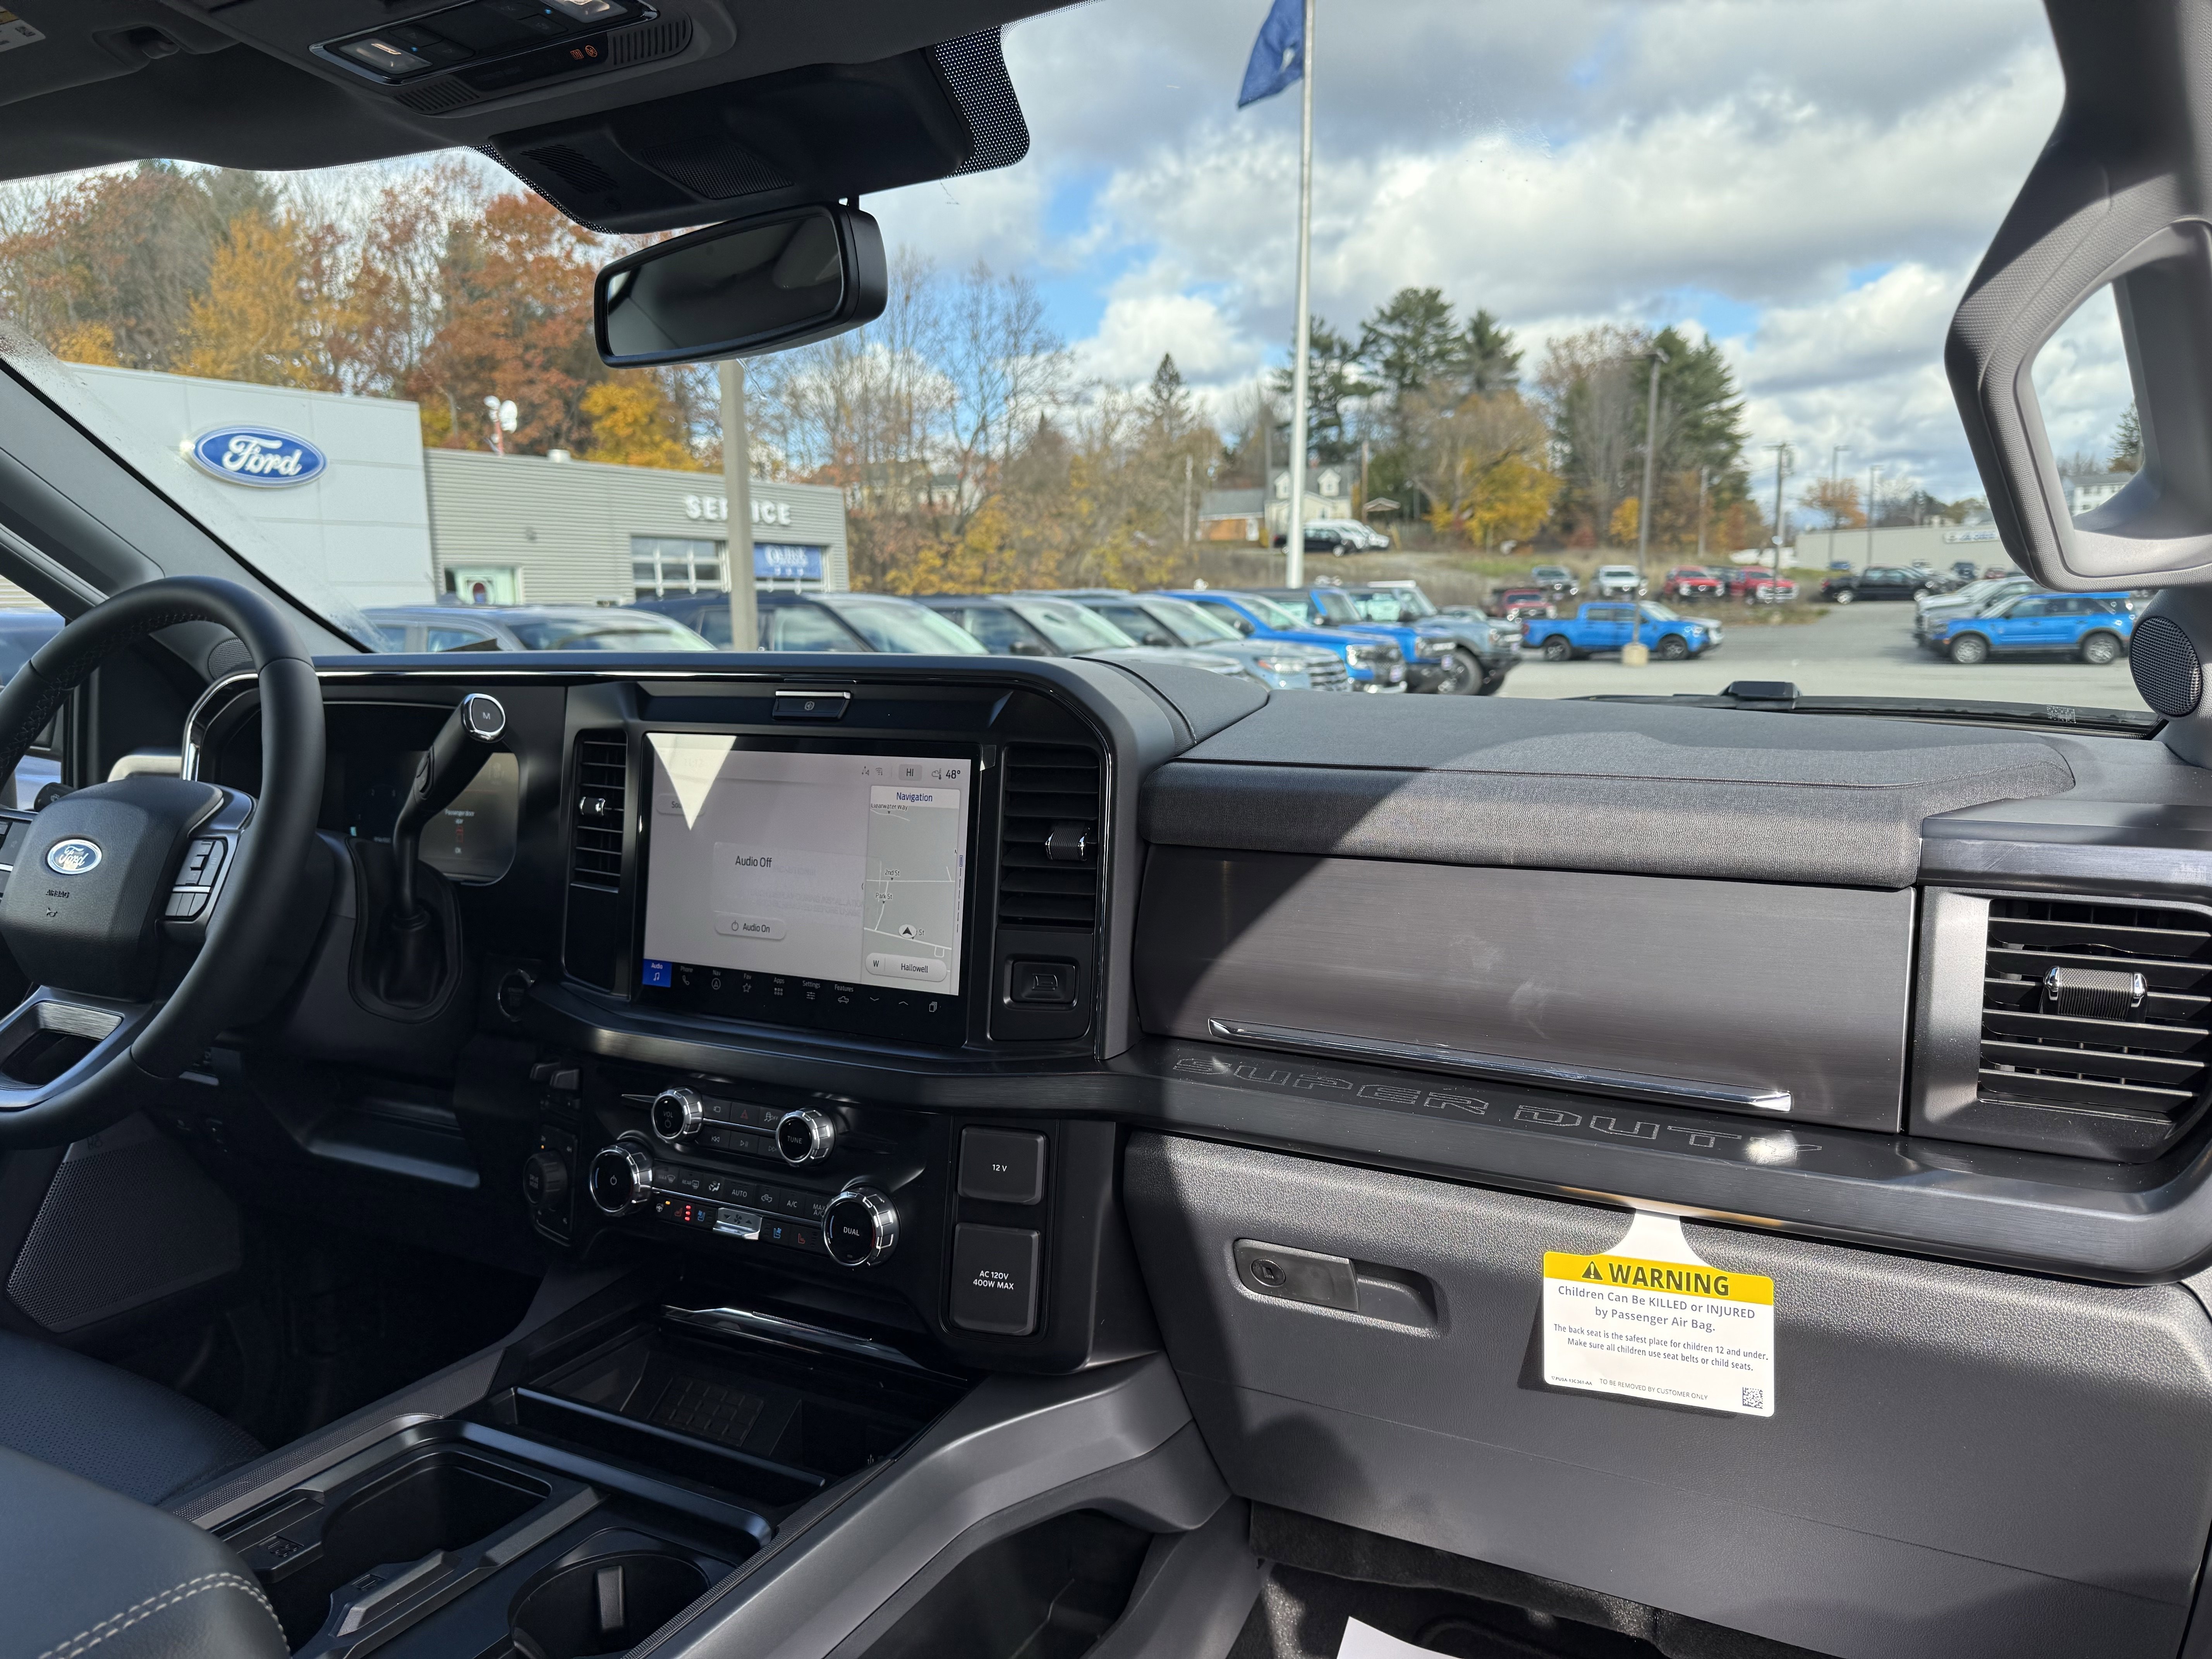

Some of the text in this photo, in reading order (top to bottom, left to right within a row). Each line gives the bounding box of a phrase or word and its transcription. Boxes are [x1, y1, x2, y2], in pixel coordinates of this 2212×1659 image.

[222, 435, 302, 476] Ford
[684, 494, 791, 525] SEICE
[483, 712, 491, 720] M
[907, 768, 914, 776] HI
[946, 770, 960, 779] 48°
[896, 792, 933, 802] Navigation
[58, 846, 89, 867] Ford
[736, 856, 772, 867] Audio Off
[743, 923, 770, 933] Audio On
[901, 963, 928, 973] Hallowell
[802, 981, 820, 989] Settings
[835, 984, 854, 992] Features
[1173, 1058, 1489, 1115] SUPER
[787, 1135, 802, 1144] TUNE
[732, 1189, 747, 1197] AUTO
[843, 1226, 860, 1236] DUAL
[991, 1271, 1008, 1280] 120V
[1609, 1262, 1729, 1296] WARNING
[973, 1279, 1014, 1290] 400W MAX
[1558, 1286, 1755, 1319] Children Can Be KILLED or INJURED
[1595, 1306, 1716, 1333] by Passenger Air Bag.
[1554, 1324, 1769, 1360] The back seat is the safest place for children 12 and under.
[1568, 1338, 1587, 1348] Make
[1606, 1343, 1615, 1352] all
[1617, 1345, 1646, 1356] children
[1649, 1350, 1661, 1358] use
[1663, 1352, 1679, 1360] seat
[1681, 1353, 1698, 1364] belts
[1711, 1358, 1729, 1367] child
[1731, 1361, 1753, 1371] seats.
[1618, 1380, 1646, 1391] REMOVED
[1657, 1387, 1690, 1398] CUSTOMER
[1691, 1392, 1708, 1400] ONLY
